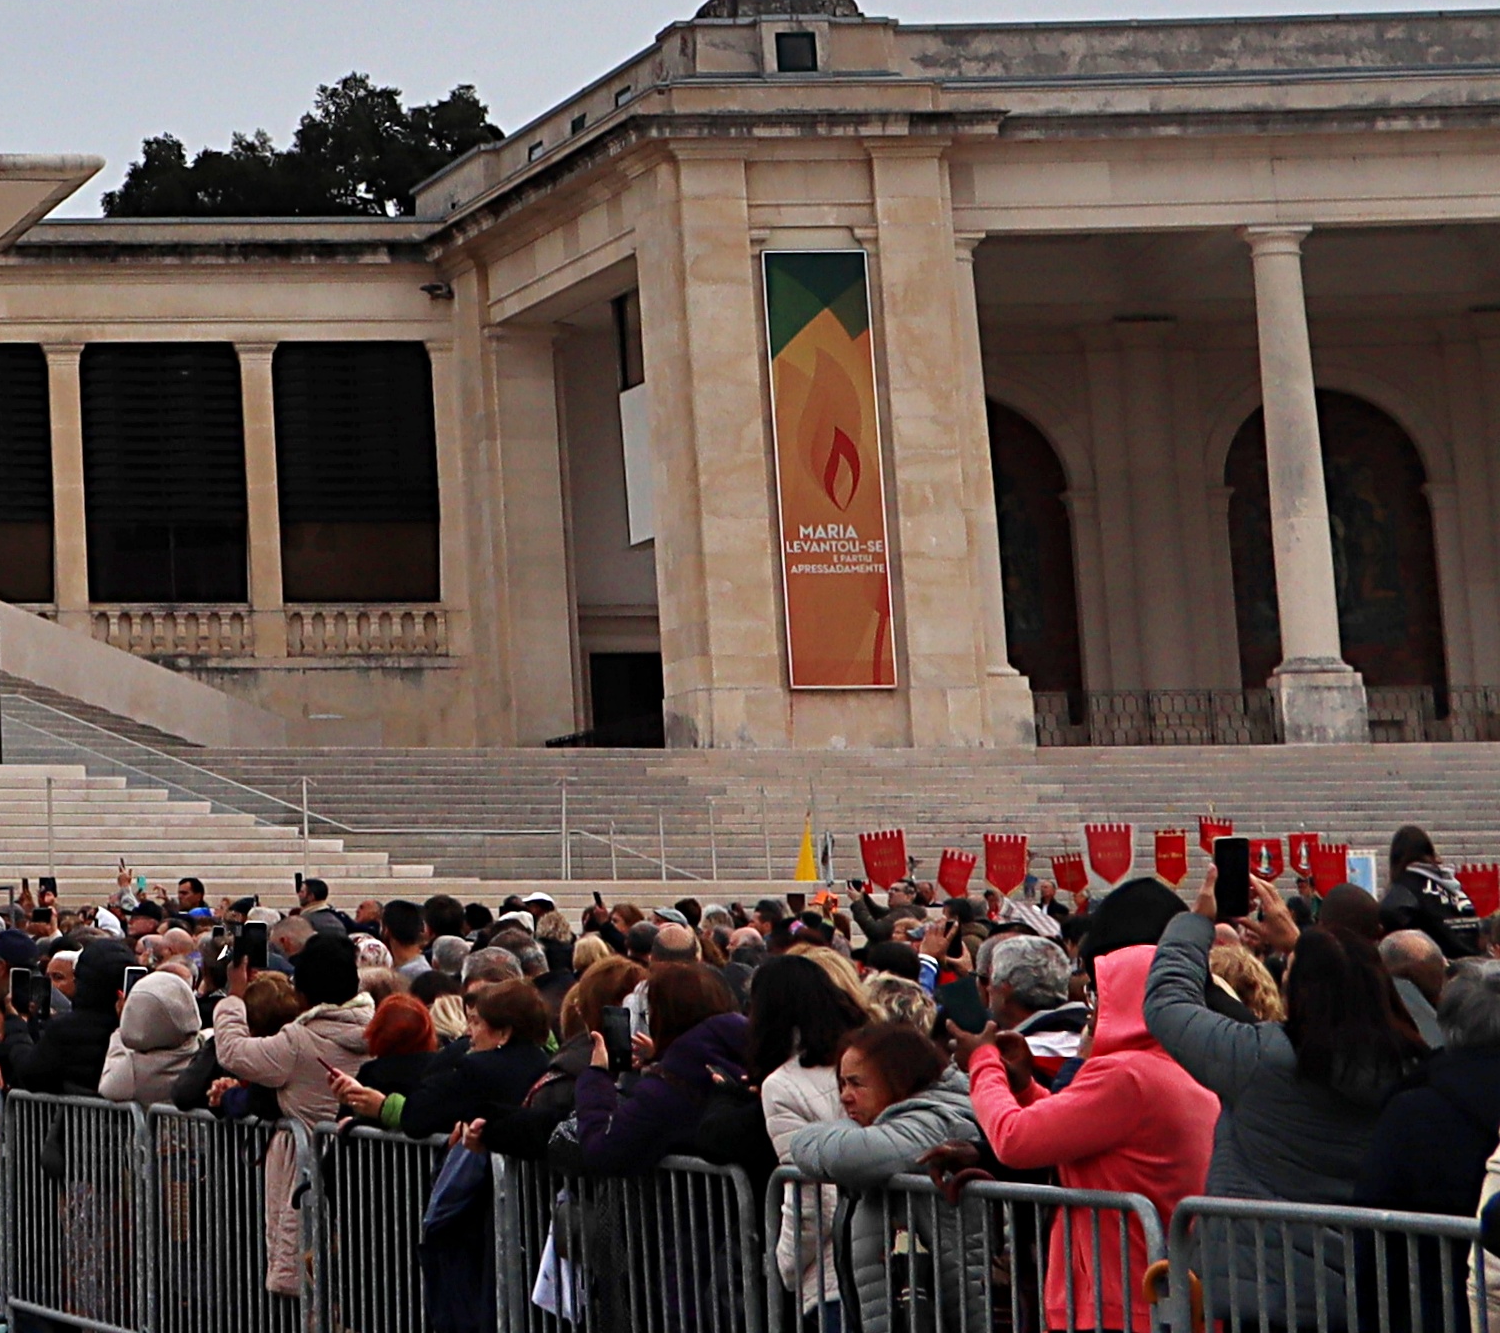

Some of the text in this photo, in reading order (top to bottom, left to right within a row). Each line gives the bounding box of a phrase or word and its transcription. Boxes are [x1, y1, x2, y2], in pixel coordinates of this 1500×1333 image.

[799, 524, 858, 539] MARIA
[786, 540, 884, 553] LEVANTOU-SE
[840, 554, 872, 563] PARTIU
[791, 564, 885, 574] APRESSADAMENTE
